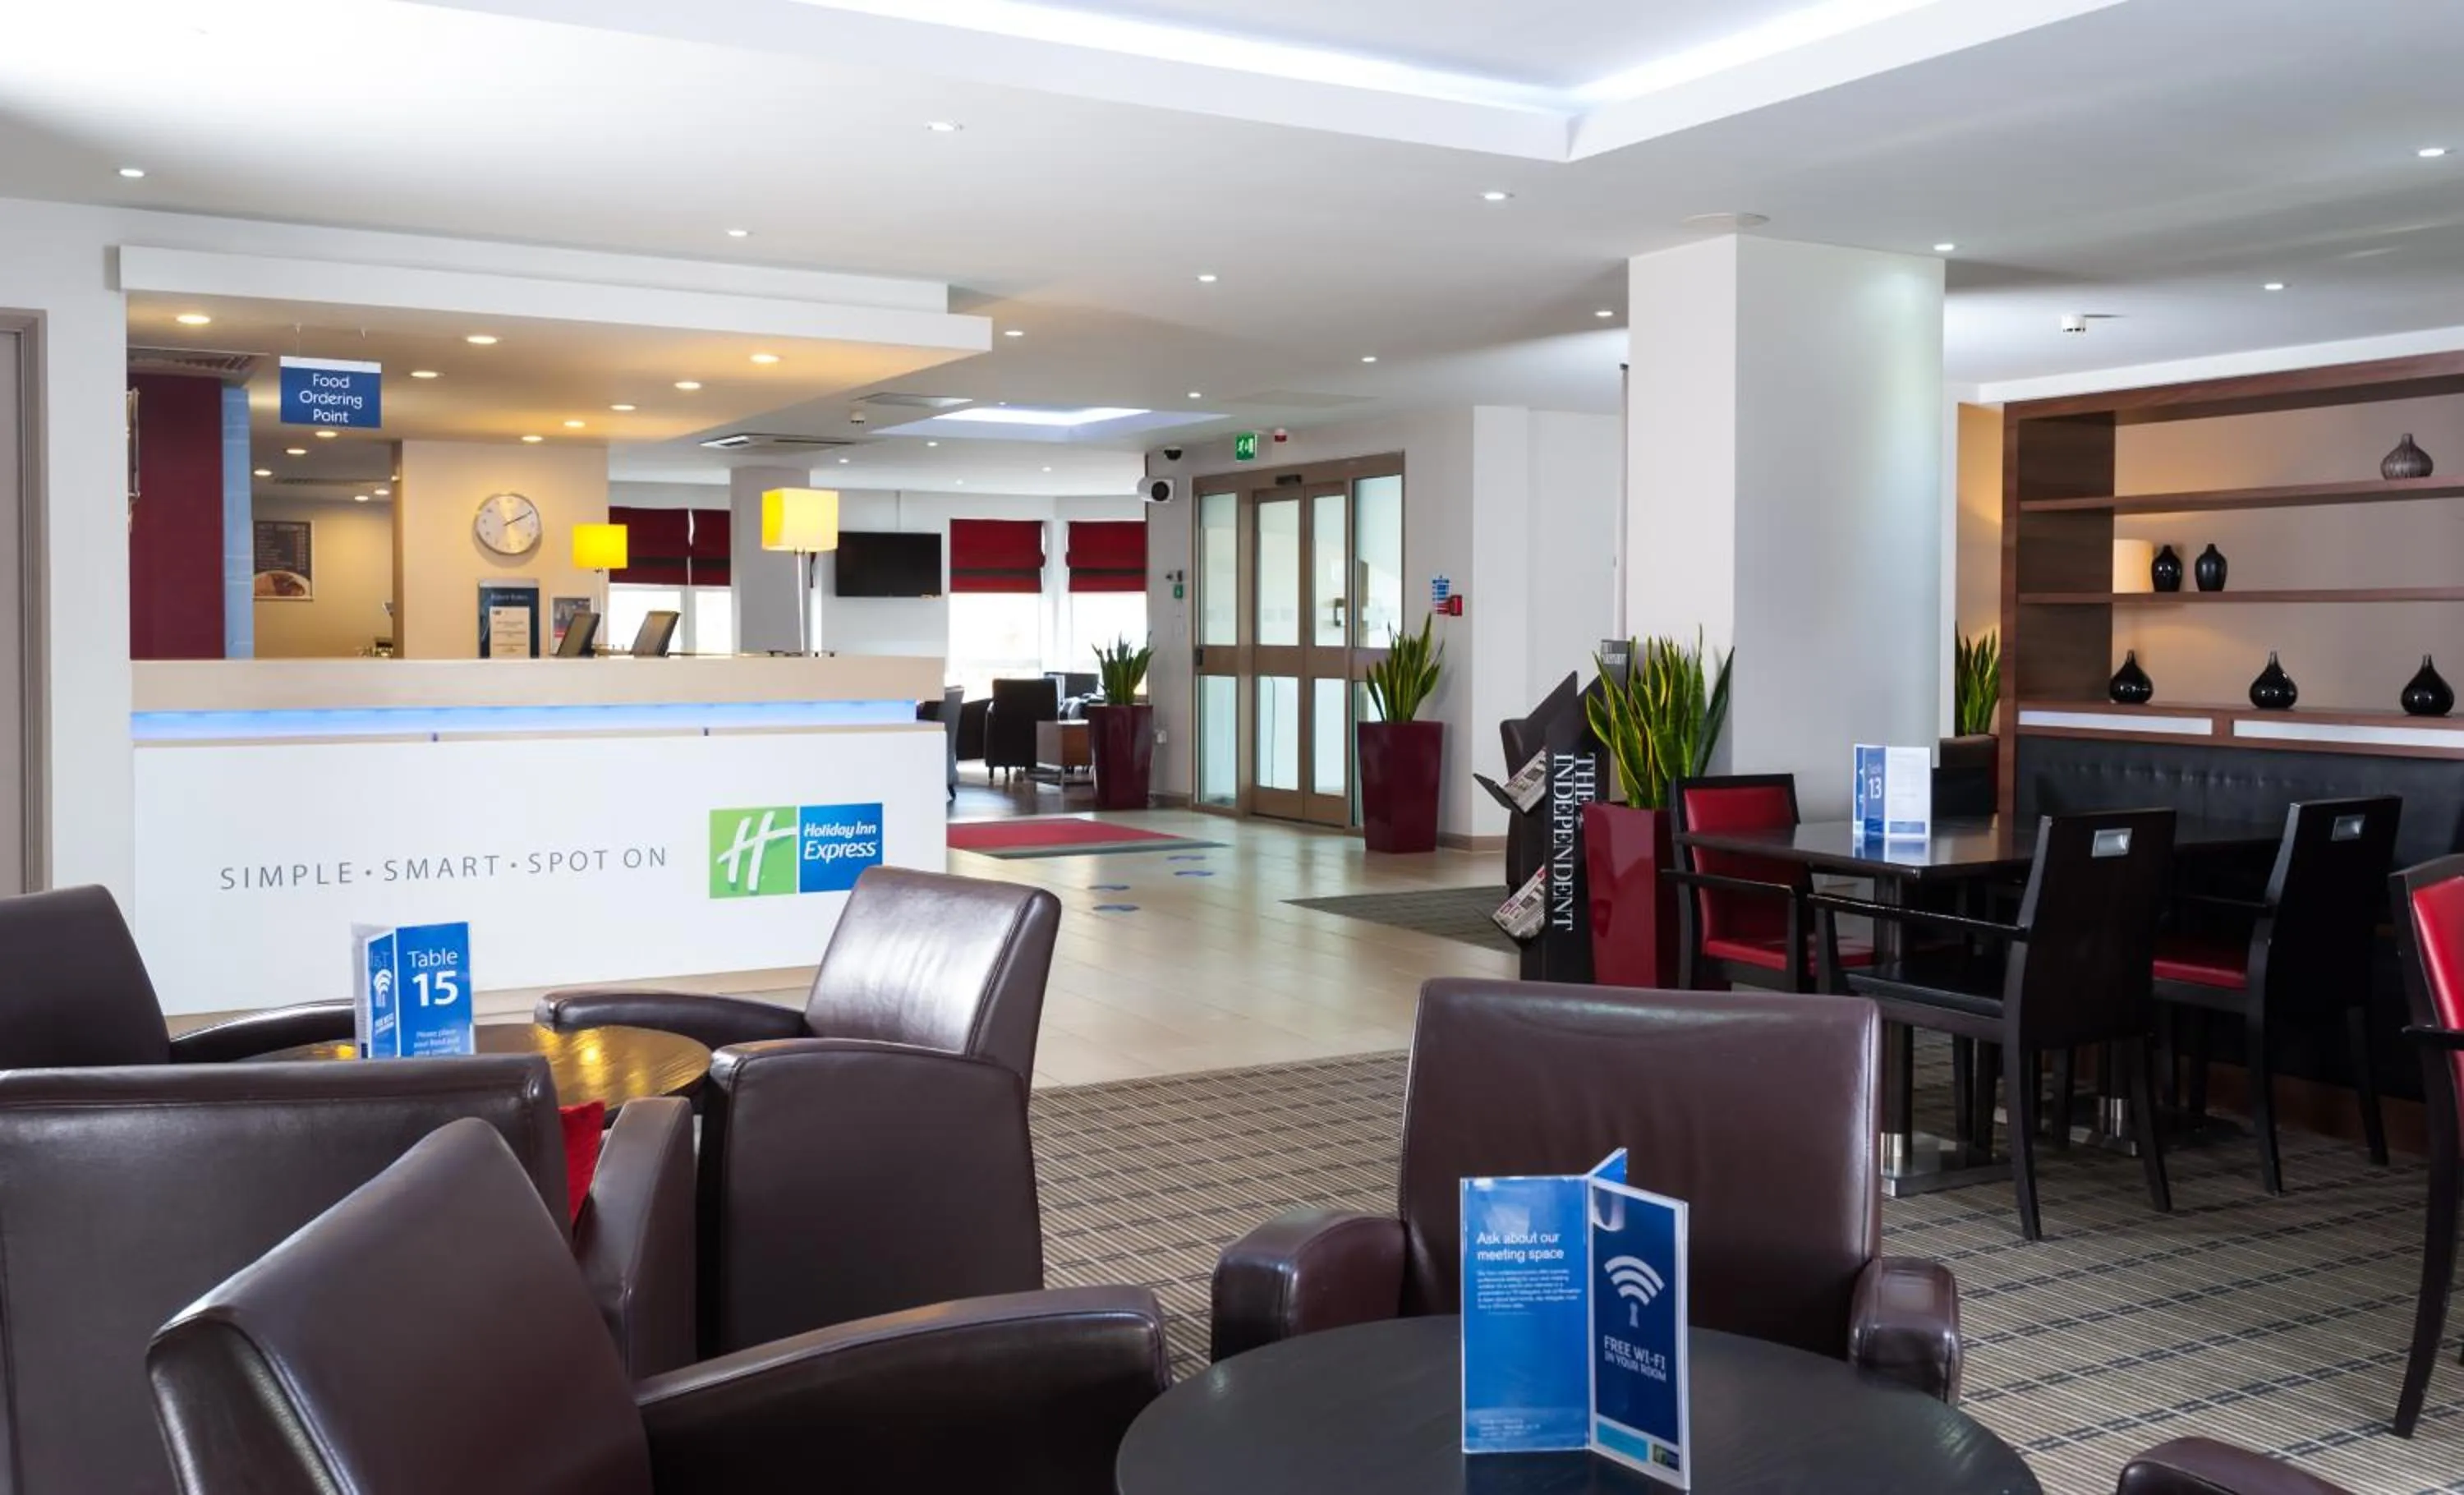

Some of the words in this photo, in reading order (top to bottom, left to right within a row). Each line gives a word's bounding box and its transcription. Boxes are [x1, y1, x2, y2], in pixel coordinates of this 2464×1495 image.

[313, 372, 350, 389] Food
[299, 390, 363, 410] Ordering
[313, 408, 349, 423] Point
[1575, 752, 1596, 806] THE
[1869, 776, 1882, 799] 13
[803, 822, 856, 840] Holiday
[856, 821, 877, 835] Inn
[1552, 752, 1575, 931] INDEPENDENT
[803, 840, 877, 863] Express
[220, 862, 353, 890] SIMPLE
[384, 855, 500, 881] SMART
[528, 849, 608, 874] SPOT
[623, 847, 666, 869] ON
[407, 948, 459, 968] Table
[411, 970, 459, 1007] 15
[1477, 1232, 1501, 1244] Ask
[1504, 1232, 1538, 1244] about
[1540, 1233, 1561, 1244] our
[1478, 1248, 1526, 1264] meeting
[1529, 1249, 1565, 1263] space
[1604, 1335, 1632, 1358] FREE
[1633, 1345, 1666, 1371] WI-FI
[1604, 1350, 1615, 1364] IN
[1616, 1355, 1639, 1373] YOUR
[1640, 1364, 1666, 1383] ROOM
